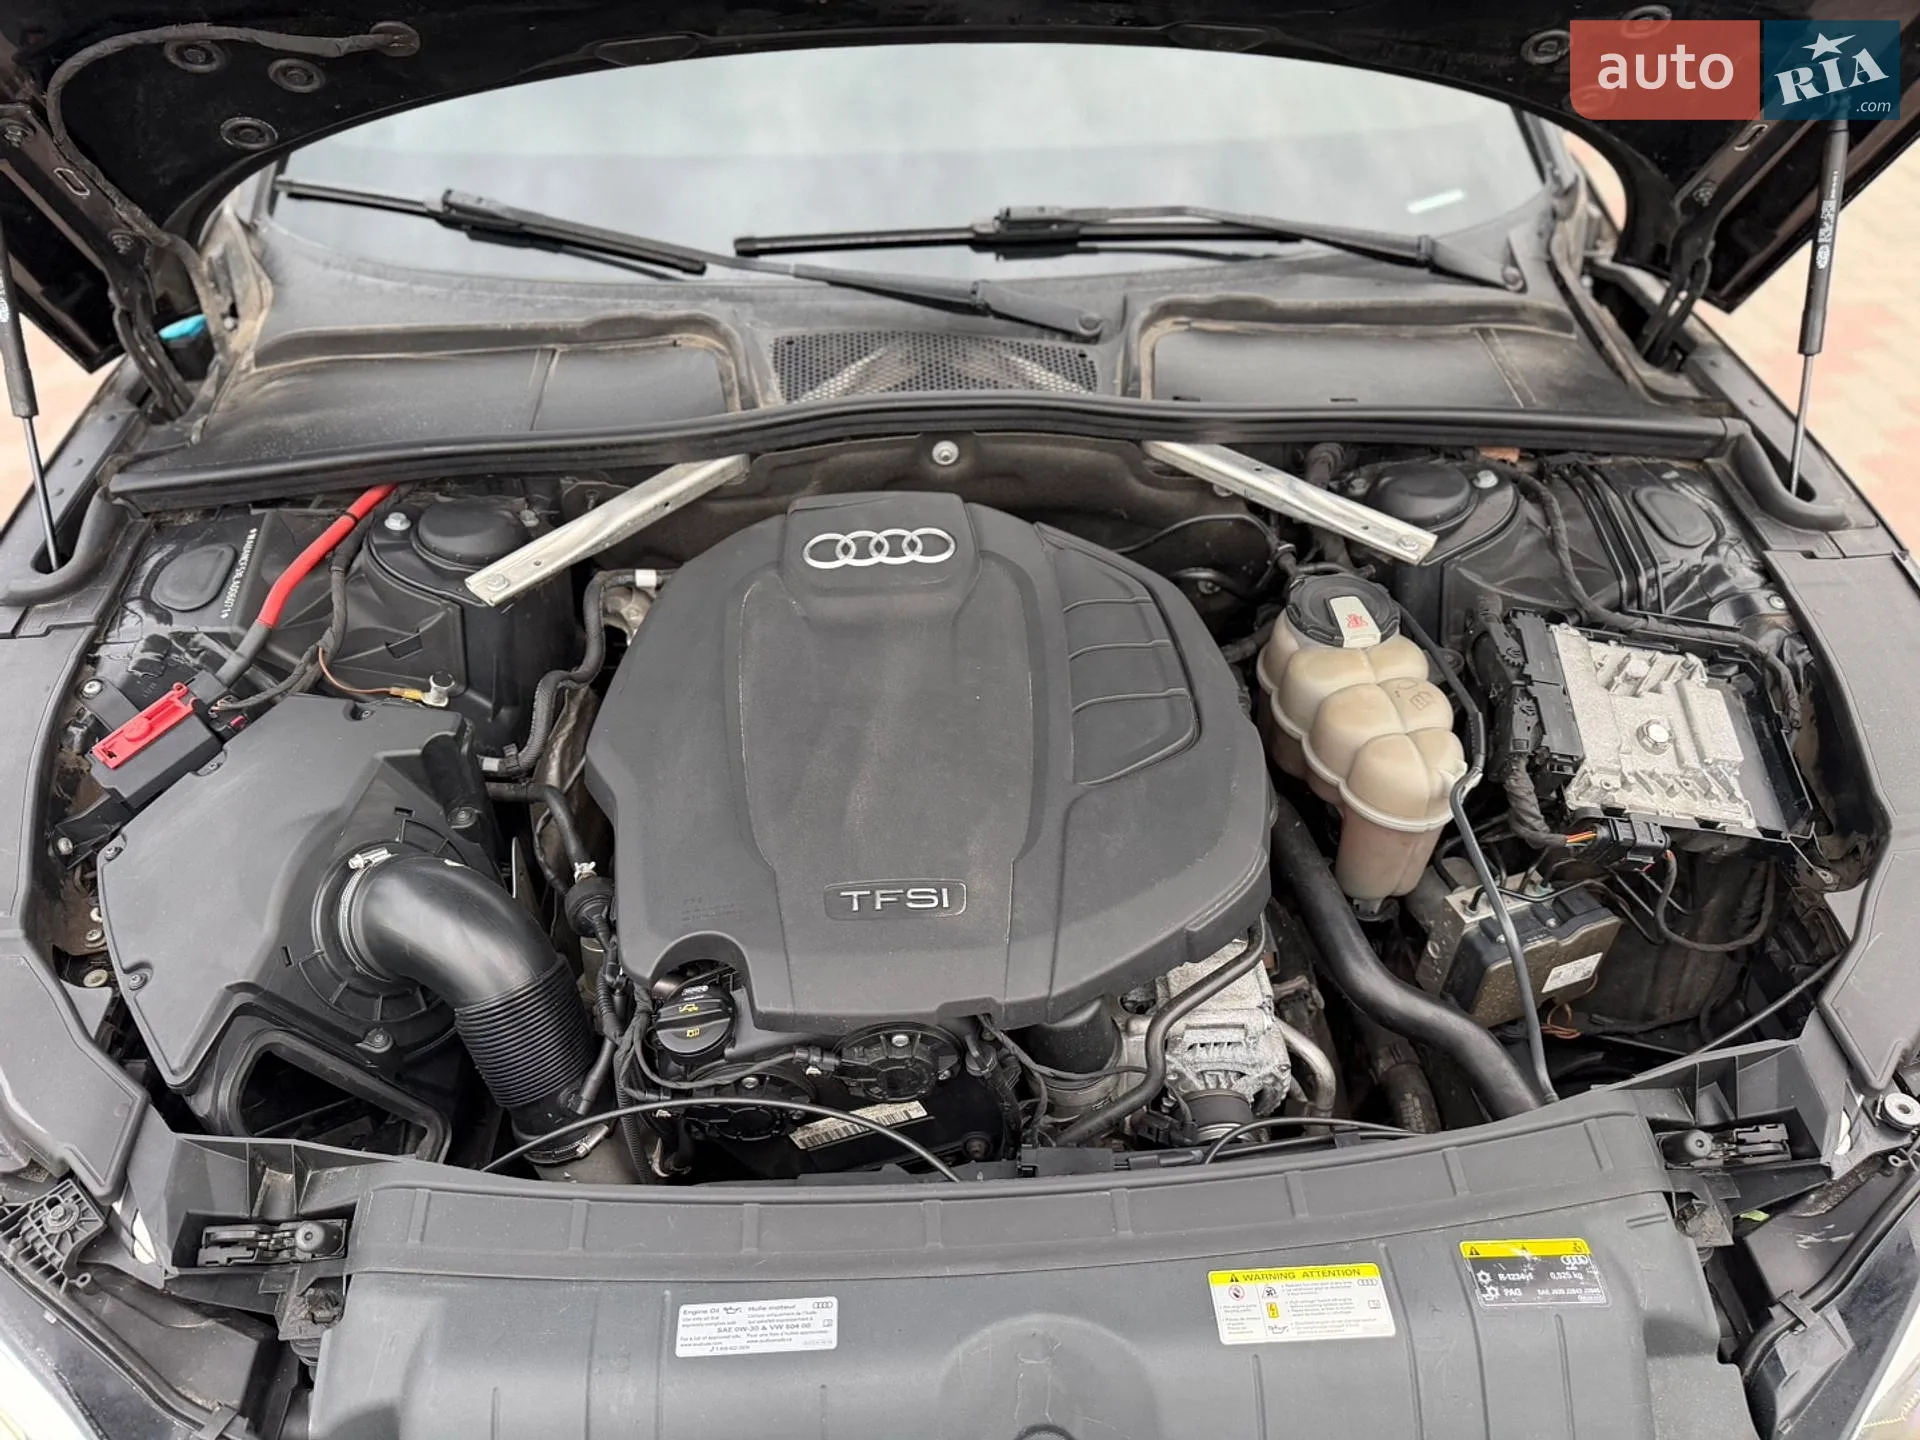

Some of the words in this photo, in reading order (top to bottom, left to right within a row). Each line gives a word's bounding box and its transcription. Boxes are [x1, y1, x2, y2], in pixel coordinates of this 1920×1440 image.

[840, 888, 949, 911] TFSI
[1242, 1272, 1296, 1281] WARNING
[1302, 1268, 1361, 1278] ATTENTION
